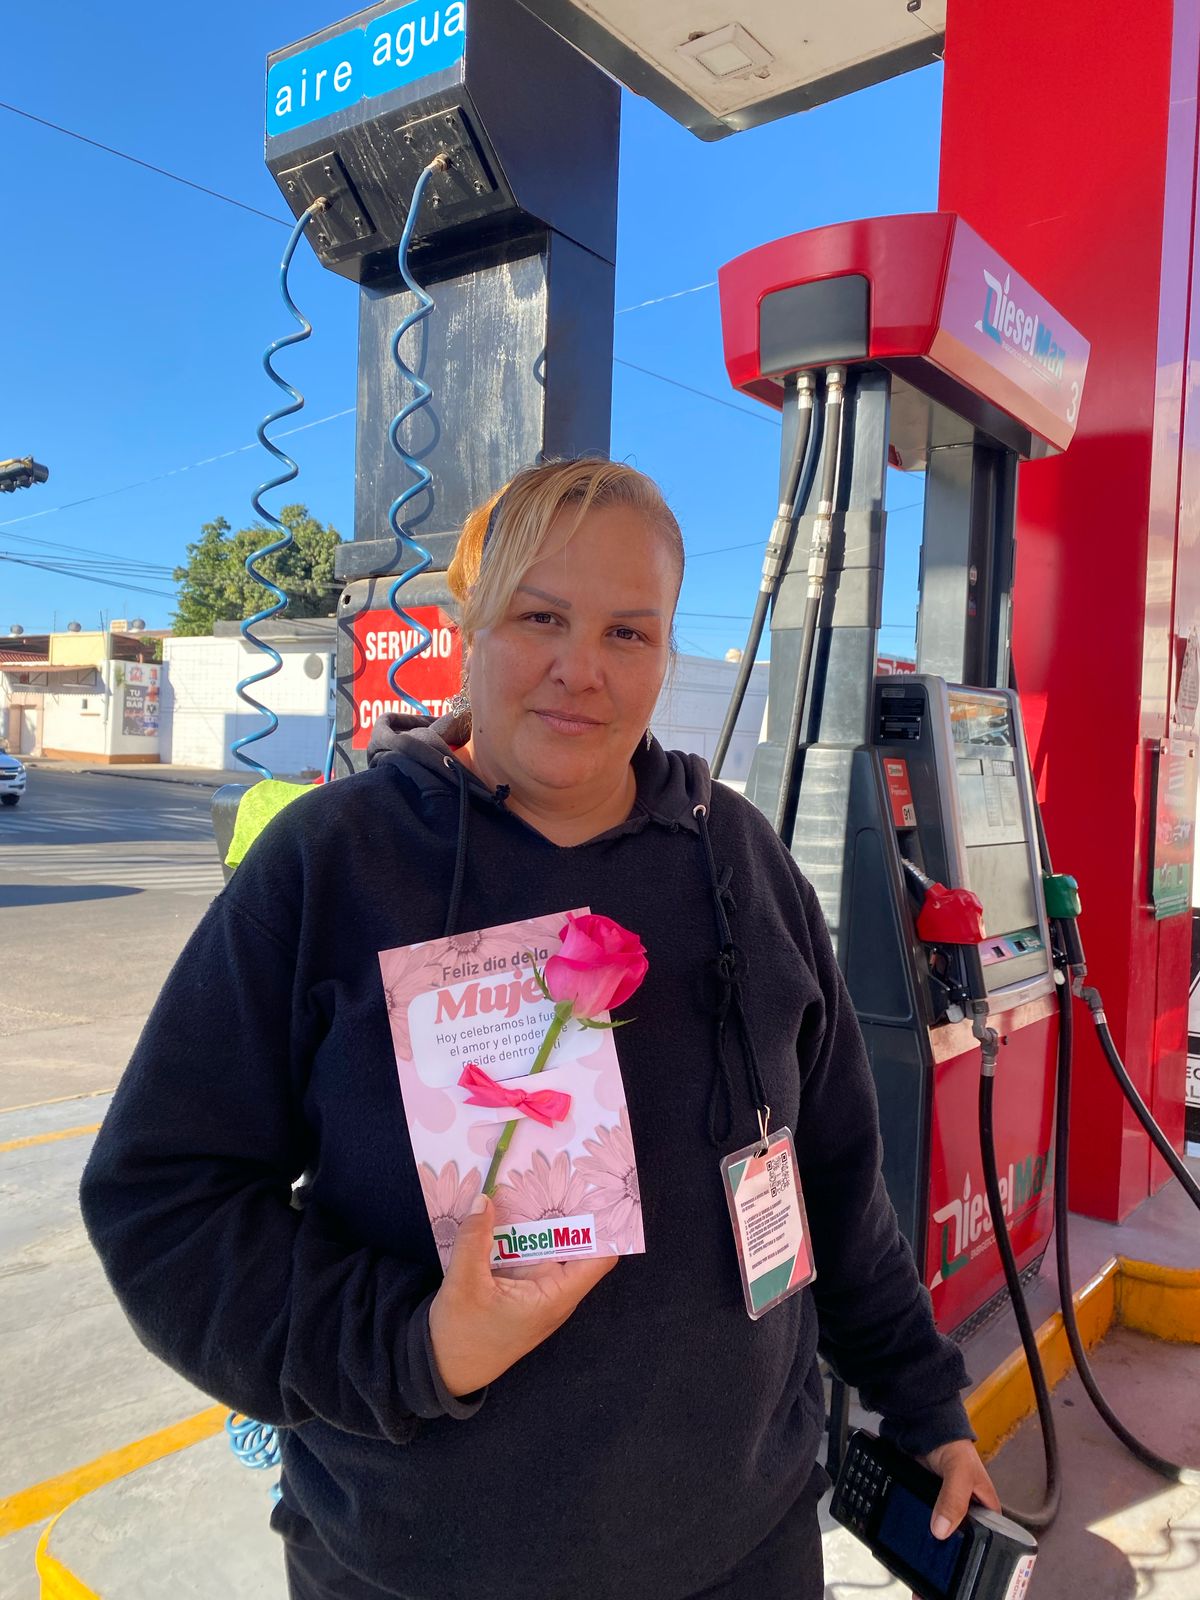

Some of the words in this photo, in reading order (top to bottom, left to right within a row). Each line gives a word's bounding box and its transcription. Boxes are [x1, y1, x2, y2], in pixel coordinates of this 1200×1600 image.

[275, 61, 352, 116] aire
[373, 1, 464, 67] agua
[975, 269, 1066, 379] DieselMax
[1066, 381, 1080, 423] 3
[443, 962, 480, 981] Feliz
[483, 955, 507, 972] día
[511, 952, 531, 966] de
[534, 948, 549, 961] la
[434, 967, 545, 1025] Muje
[436, 1034, 457, 1045] Hoy
[460, 1018, 525, 1040] celebramos
[526, 1015, 537, 1025] la
[538, 1012, 556, 1023] fue
[450, 1046, 460, 1057] el
[462, 1040, 491, 1054] amor
[492, 1039, 500, 1049] y
[501, 1035, 512, 1046] el
[514, 1028, 546, 1045] poder
[498, 1046, 535, 1061] dentro
[493, 1226, 592, 1261] DieselMax
